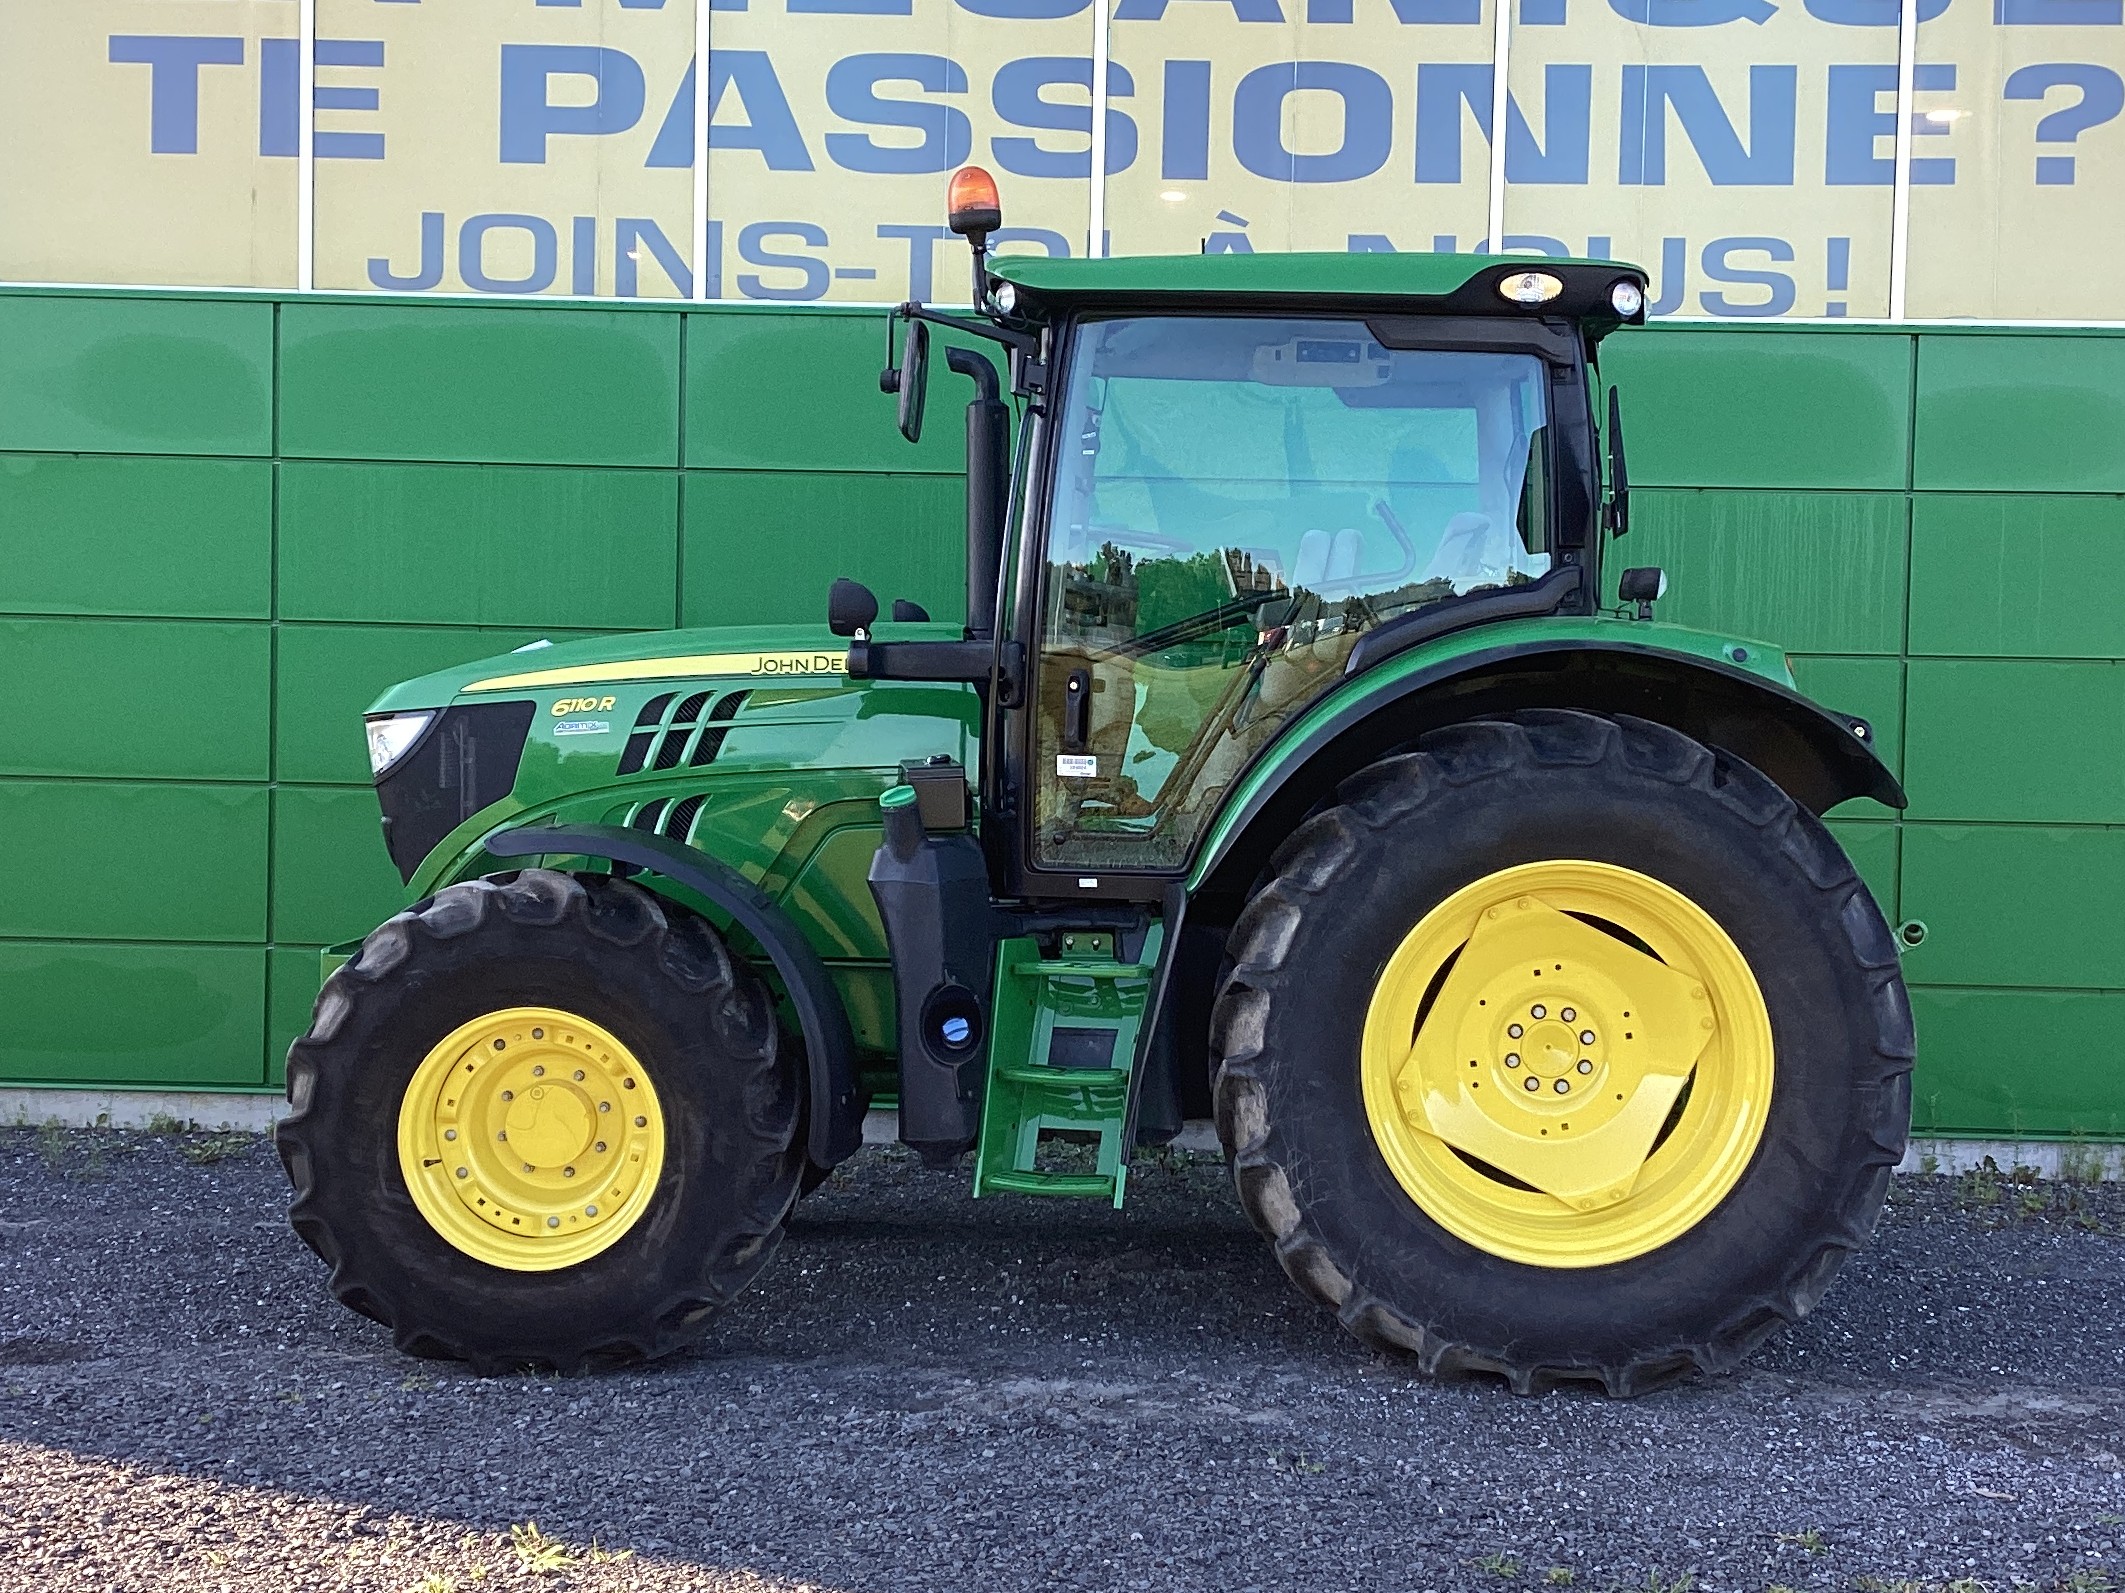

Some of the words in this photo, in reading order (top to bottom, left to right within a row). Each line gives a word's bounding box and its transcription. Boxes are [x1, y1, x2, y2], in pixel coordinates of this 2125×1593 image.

[108, 35, 386, 159] TE
[751, 657, 809, 672] JOHN
[813, 656, 849, 670] DE
